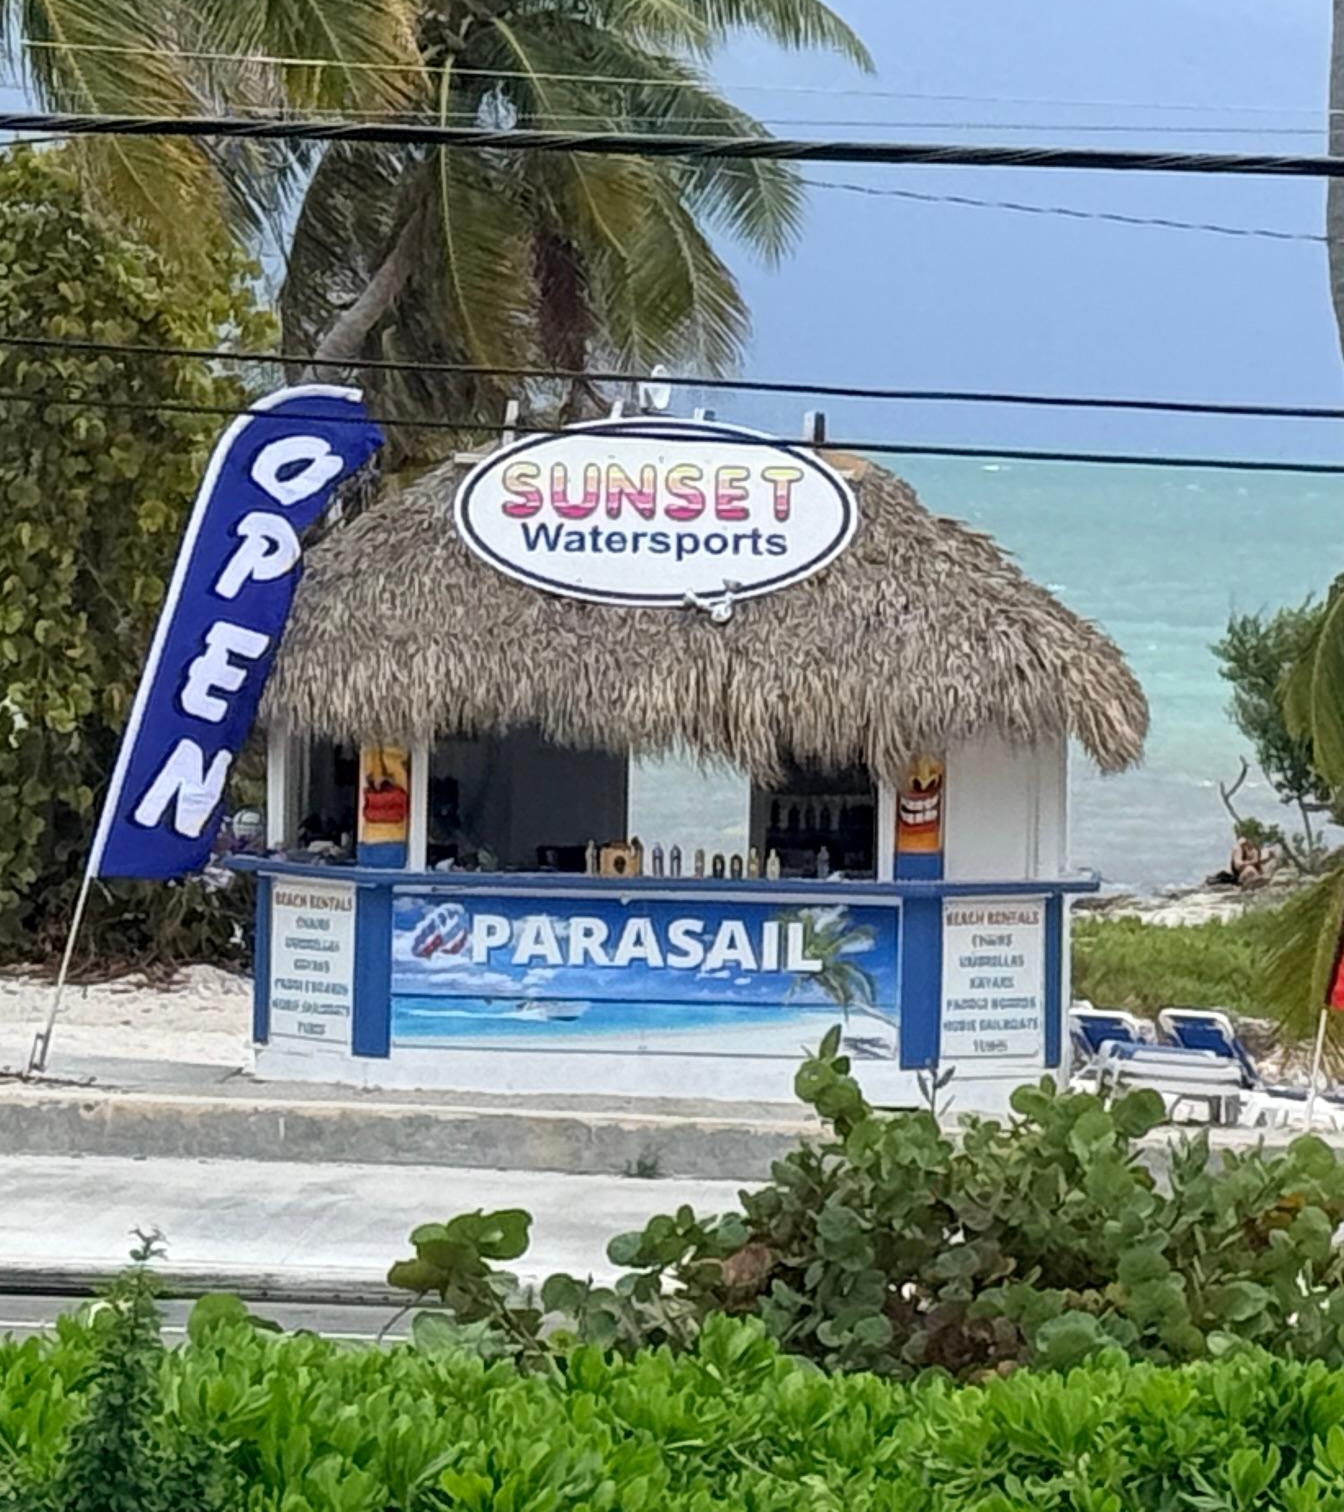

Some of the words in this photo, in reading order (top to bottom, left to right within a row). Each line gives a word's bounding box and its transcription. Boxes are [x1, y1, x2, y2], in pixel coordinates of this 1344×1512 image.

[501, 461, 805, 521] SUNSET
[521, 522, 788, 560] Watersports
[133, 434, 344, 838] OPEN
[471, 913, 823, 973] PARASAIL
